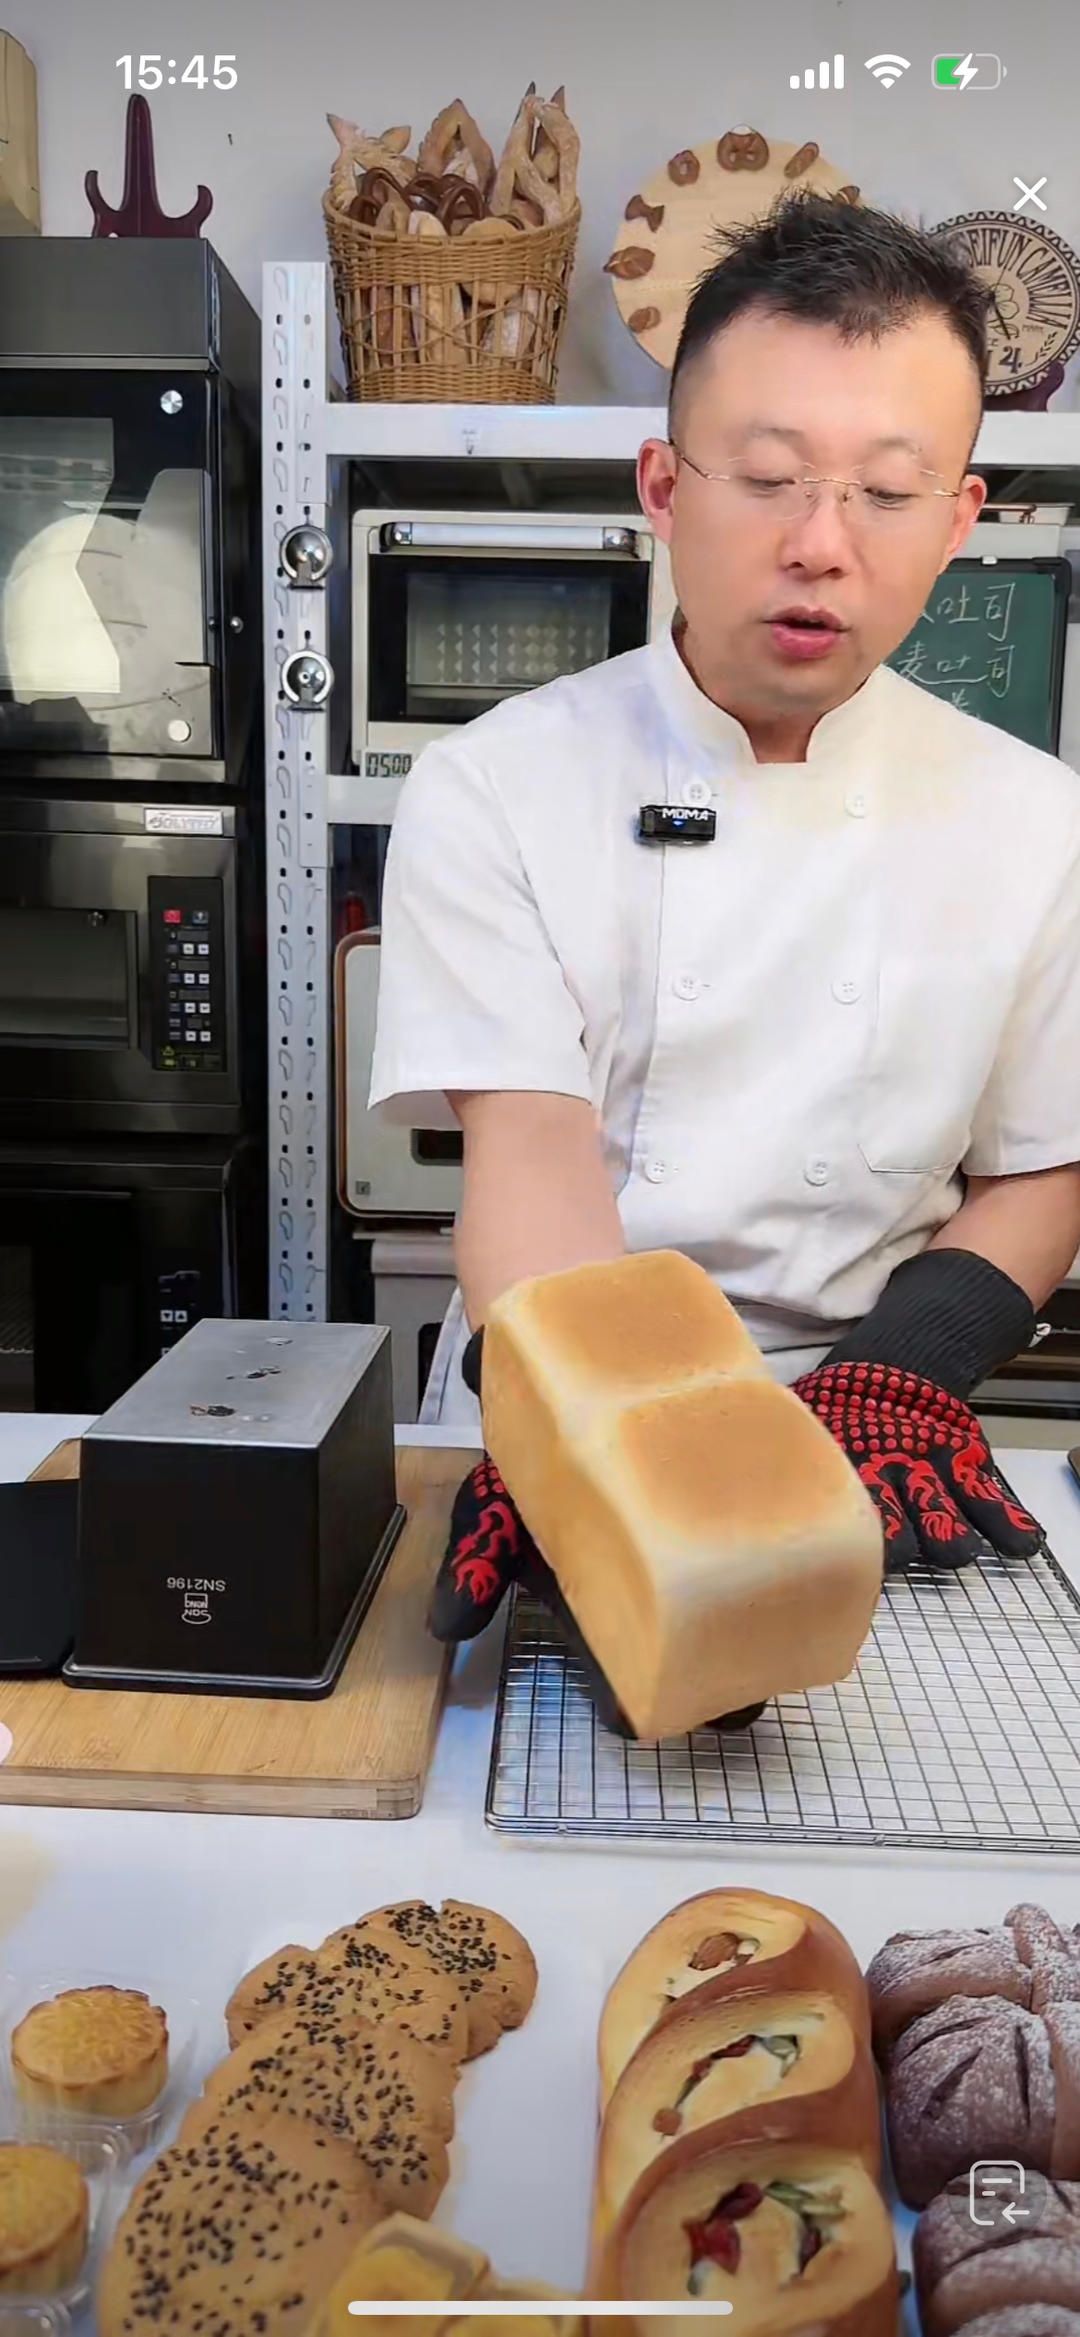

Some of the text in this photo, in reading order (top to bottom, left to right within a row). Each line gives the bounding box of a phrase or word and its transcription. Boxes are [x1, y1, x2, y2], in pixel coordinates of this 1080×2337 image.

[922, 582, 1016, 642] 吐司
[661, 807, 710, 820] MOMA
[166, 1576, 227, 1592] SN2196
